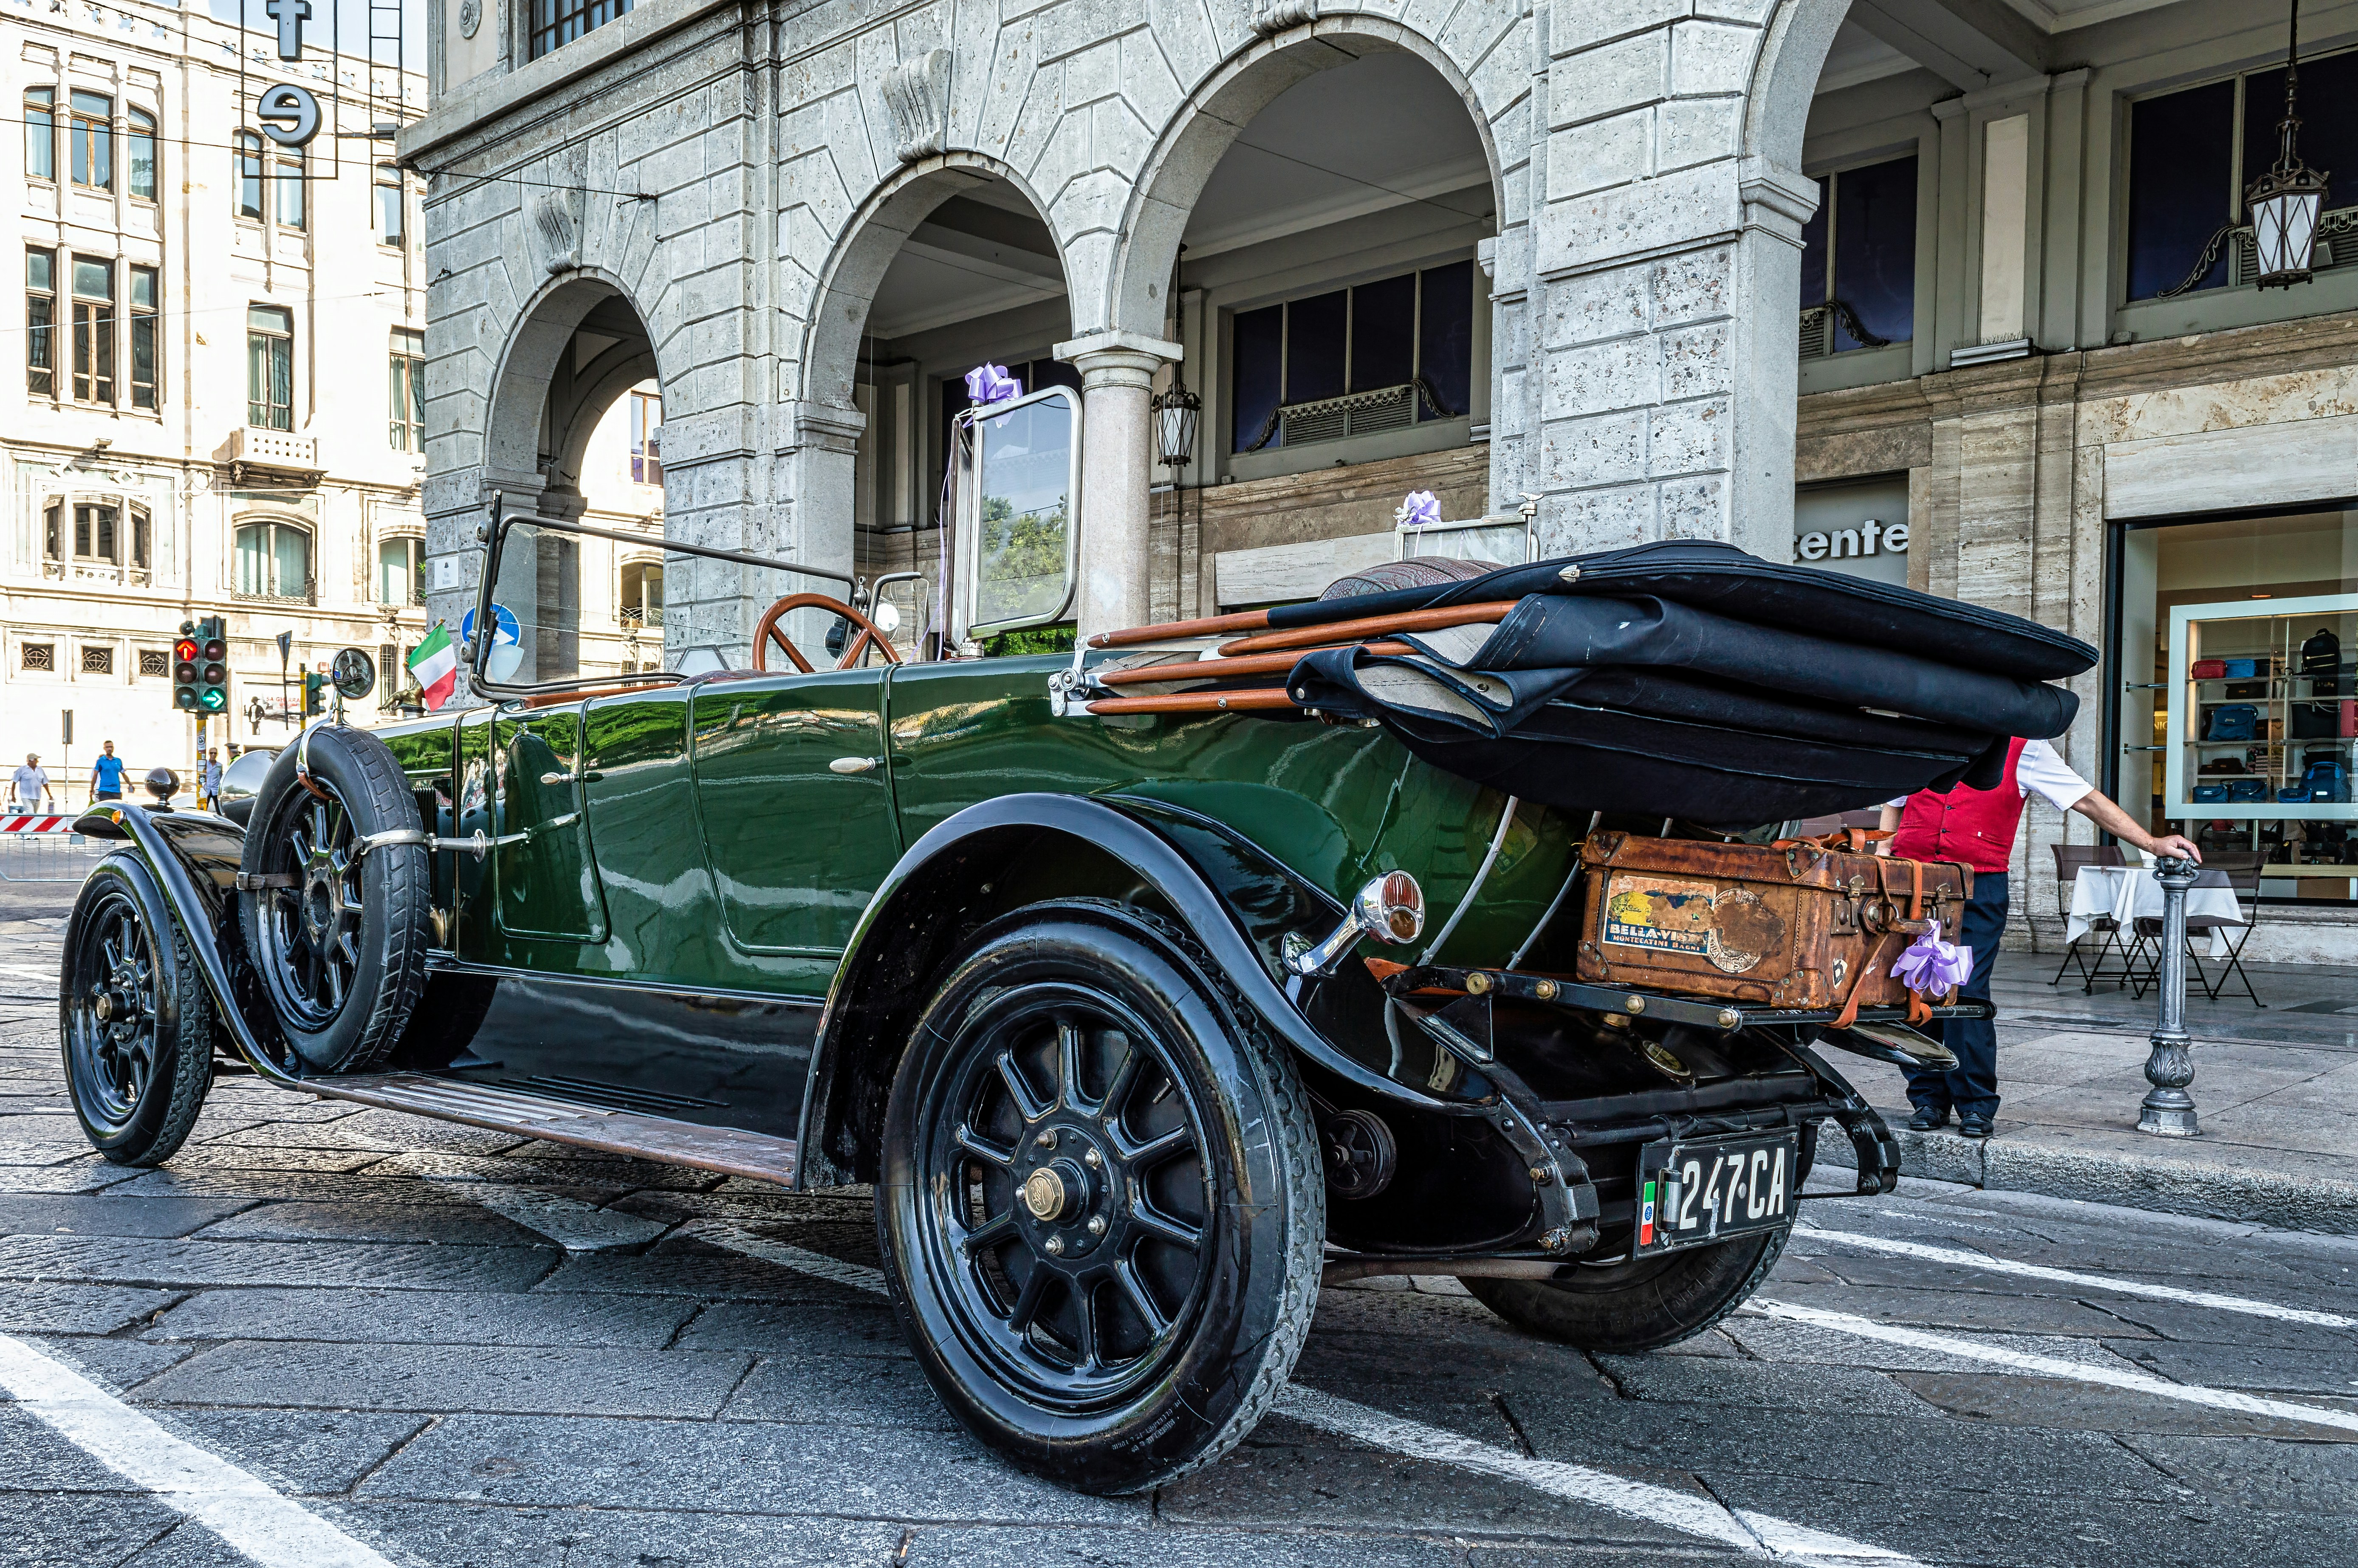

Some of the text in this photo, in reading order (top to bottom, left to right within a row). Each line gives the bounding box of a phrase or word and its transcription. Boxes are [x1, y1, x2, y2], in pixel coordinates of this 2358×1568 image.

[1793, 519, 1908, 561] ente
[1612, 935, 1700, 951] MONTECATINI BAGNI
